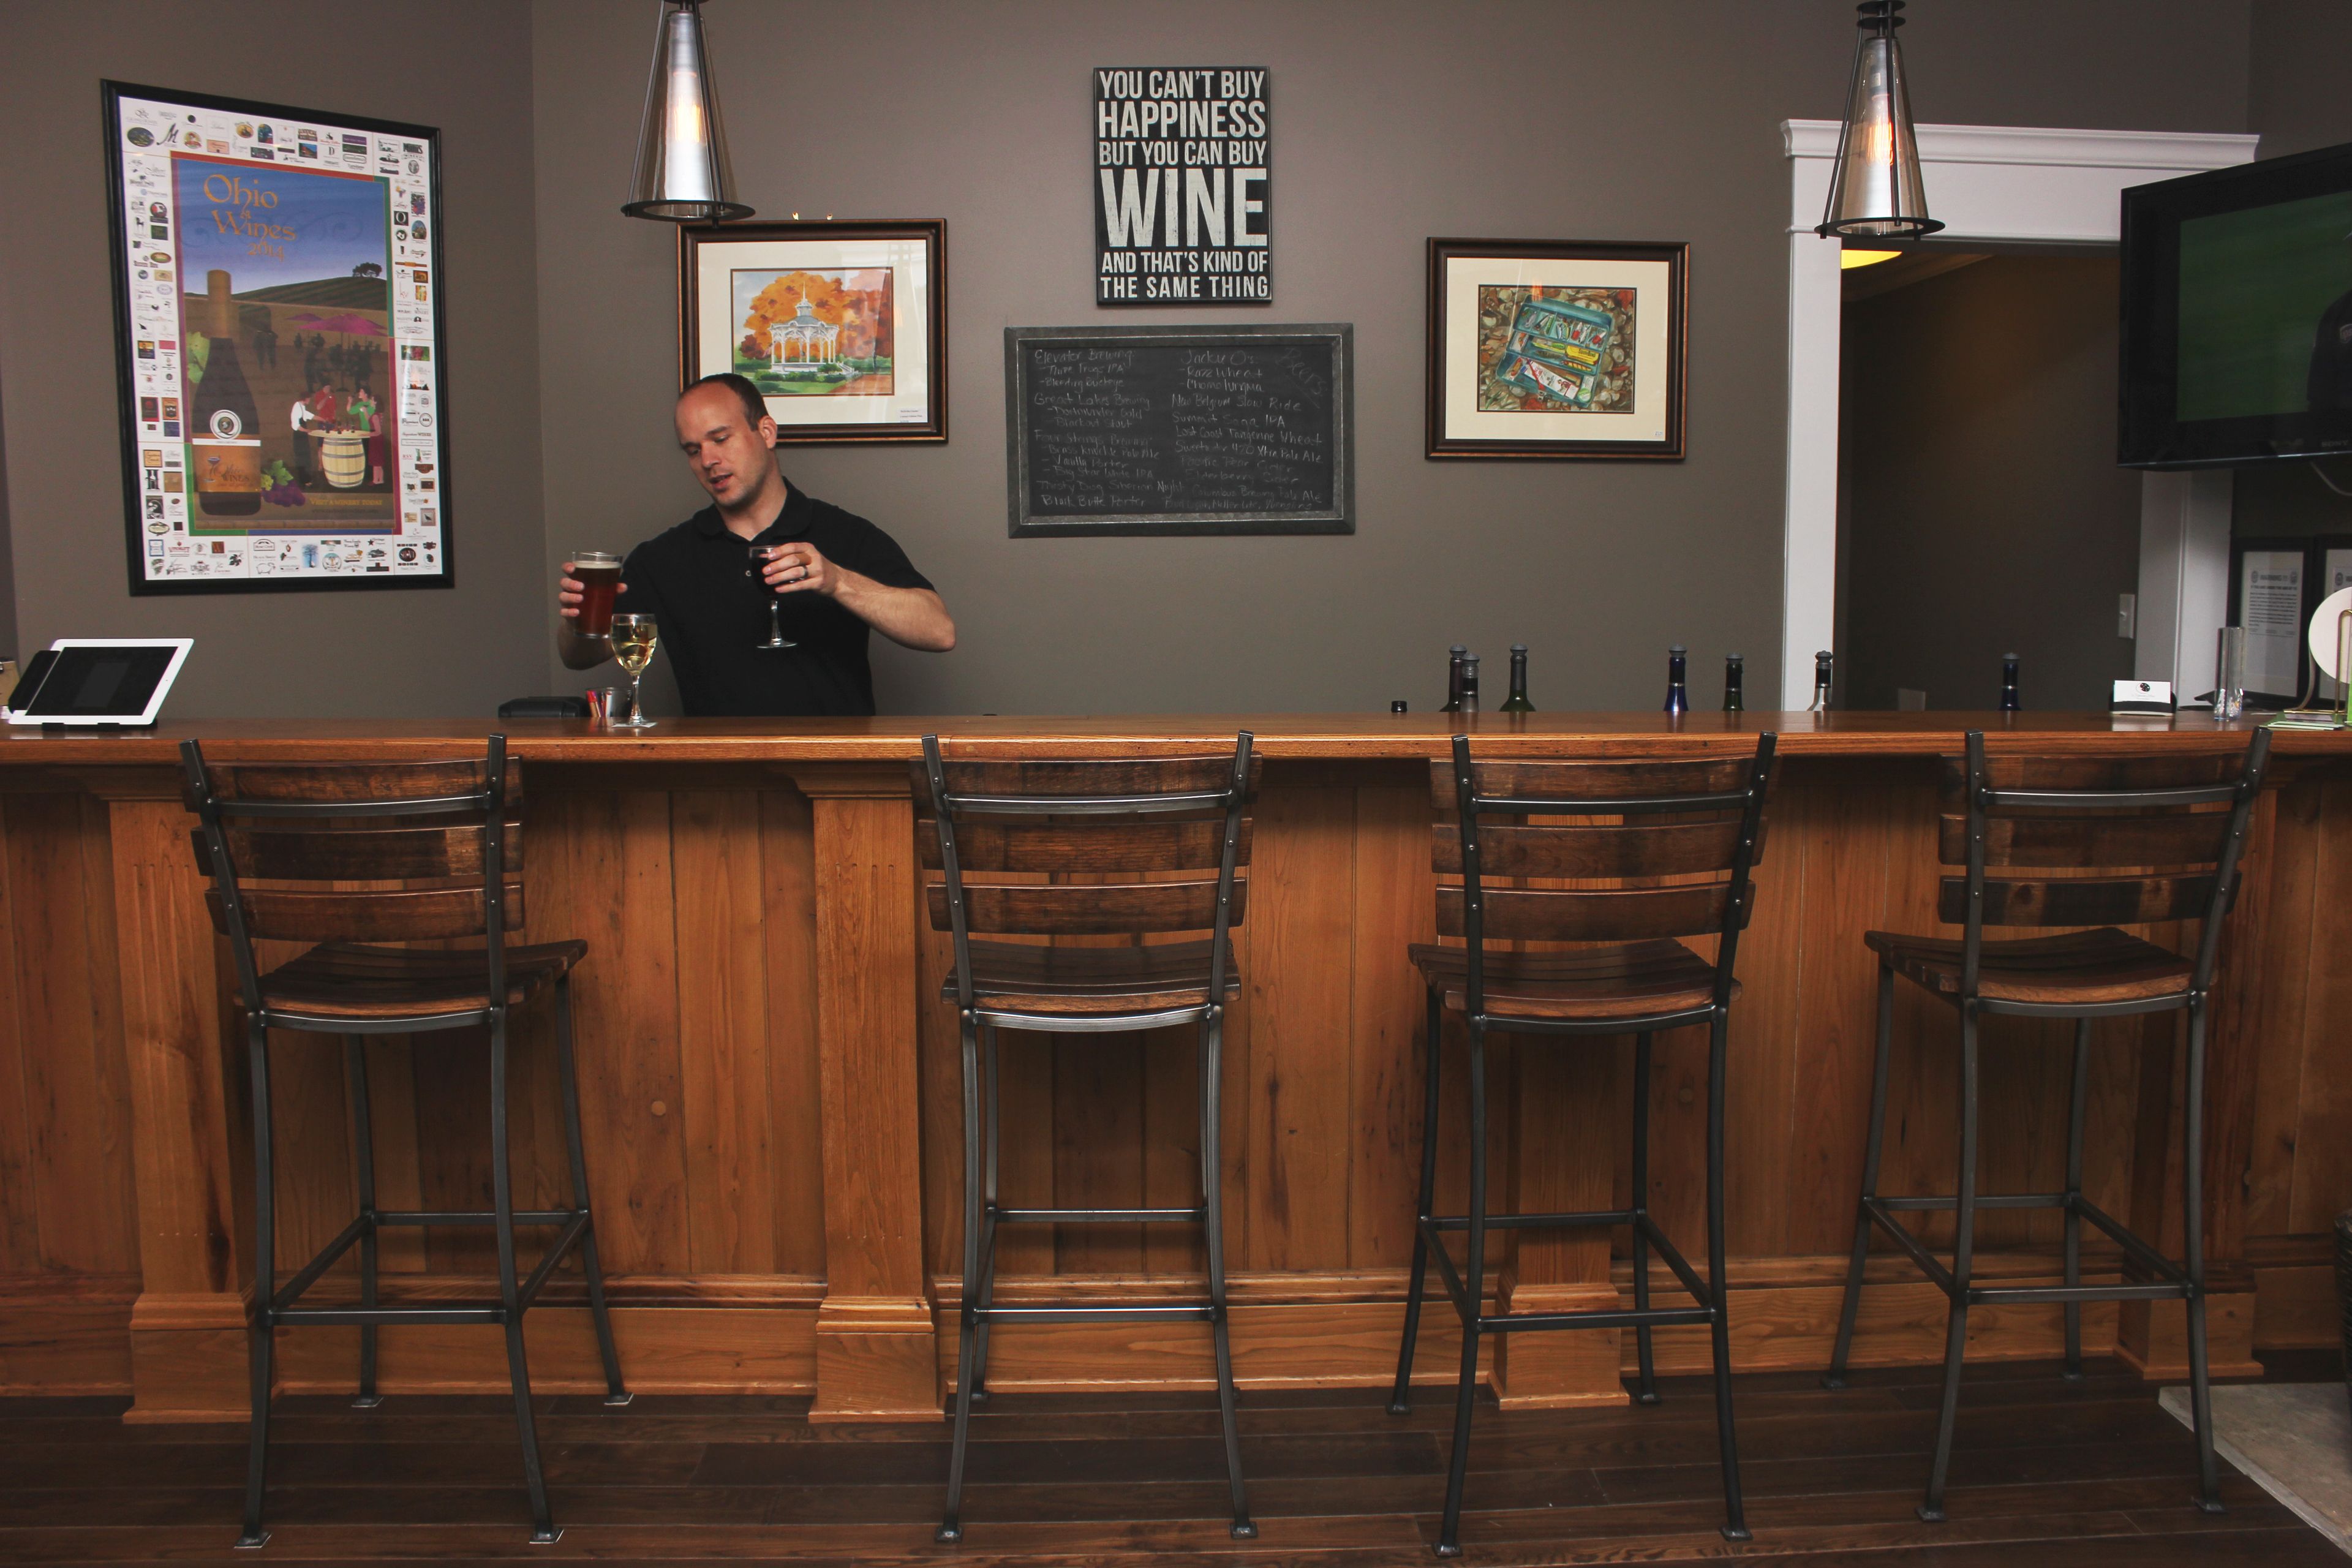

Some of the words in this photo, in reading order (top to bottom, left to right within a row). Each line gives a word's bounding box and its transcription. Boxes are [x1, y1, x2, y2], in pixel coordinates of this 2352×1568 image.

[1100, 70, 1142, 99] YOU
[1149, 70, 1215, 99] CAN'T
[1221, 70, 1265, 99] BUY
[1099, 100, 1266, 138] HAPPINESS
[1099, 141, 1136, 166] BUT
[1140, 141, 1179, 166] YOU
[1185, 141, 1223, 166] CAN
[1229, 141, 1267, 166] BUY
[203, 174, 279, 214] Ohio
[1100, 168, 1268, 247] WINE
[211, 209, 297, 242] Wines
[247, 241, 284, 262] 2014
[1102, 252, 1136, 273] AND
[1140, 252, 1199, 273] THAT'S
[1204, 251, 1243, 273] KIND
[1248, 251, 1268, 273] OF
[1100, 276, 1137, 298] THE
[1147, 276, 1200, 298] SAME
[1208, 276, 1268, 298] THING
[1035, 349, 1082, 364] Elevator
[1107, 363, 1124, 373] IPA
[1216, 366, 1263, 379] Wheat
[1085, 376, 1125, 392] Buckeye
[1034, 393, 1073, 405] Great
[1078, 394, 1109, 406] Lakes
[1113, 393, 1150, 411] Brewing
[1171, 393, 1191, 408] New
[1193, 393, 1231, 411] Belgium
[1236, 394, 1263, 409] Slow
[1268, 397, 1302, 412] Ride
[1103, 418, 1132, 428] Stout
[1120, 408, 1143, 420] Gold
[1172, 411, 1218, 424] Summit
[1223, 414, 1260, 432] Saga
[1265, 414, 1286, 428] IPA
[1034, 429, 1063, 442] Four
[1175, 425, 1197, 437] Lost
[1199, 426, 1223, 439] Coast
[1225, 428, 1275, 447] Tangerine
[1280, 431, 1323, 447] Wheat
[1048, 443, 1077, 454] Brass
[1141, 448, 1161, 460] Ale
[1231, 442, 1256, 455] 420
[1257, 445, 1278, 458] Xtra
[1281, 448, 1299, 460] Pale
[1302, 450, 1324, 464] Ale
[1052, 454, 1087, 466] Vanilla
[1092, 457, 1129, 468] Porter
[1181, 455, 1218, 467] Pacific
[1222, 456, 1250, 467] Pear
[1257, 461, 1295, 473] Cider
[1053, 465, 1075, 481] Big
[1077, 467, 1101, 477] Star
[1136, 468, 1154, 478] IPA
[1185, 468, 1255, 485] Elderberry
[1263, 471, 1299, 483] Cider
[1077, 480, 1104, 496] Dog
[1192, 484, 1237, 497] Columbus
[1239, 485, 1275, 499] Brewing
[1302, 490, 1324, 503] Ale
[1110, 494, 1146, 507] Porter
